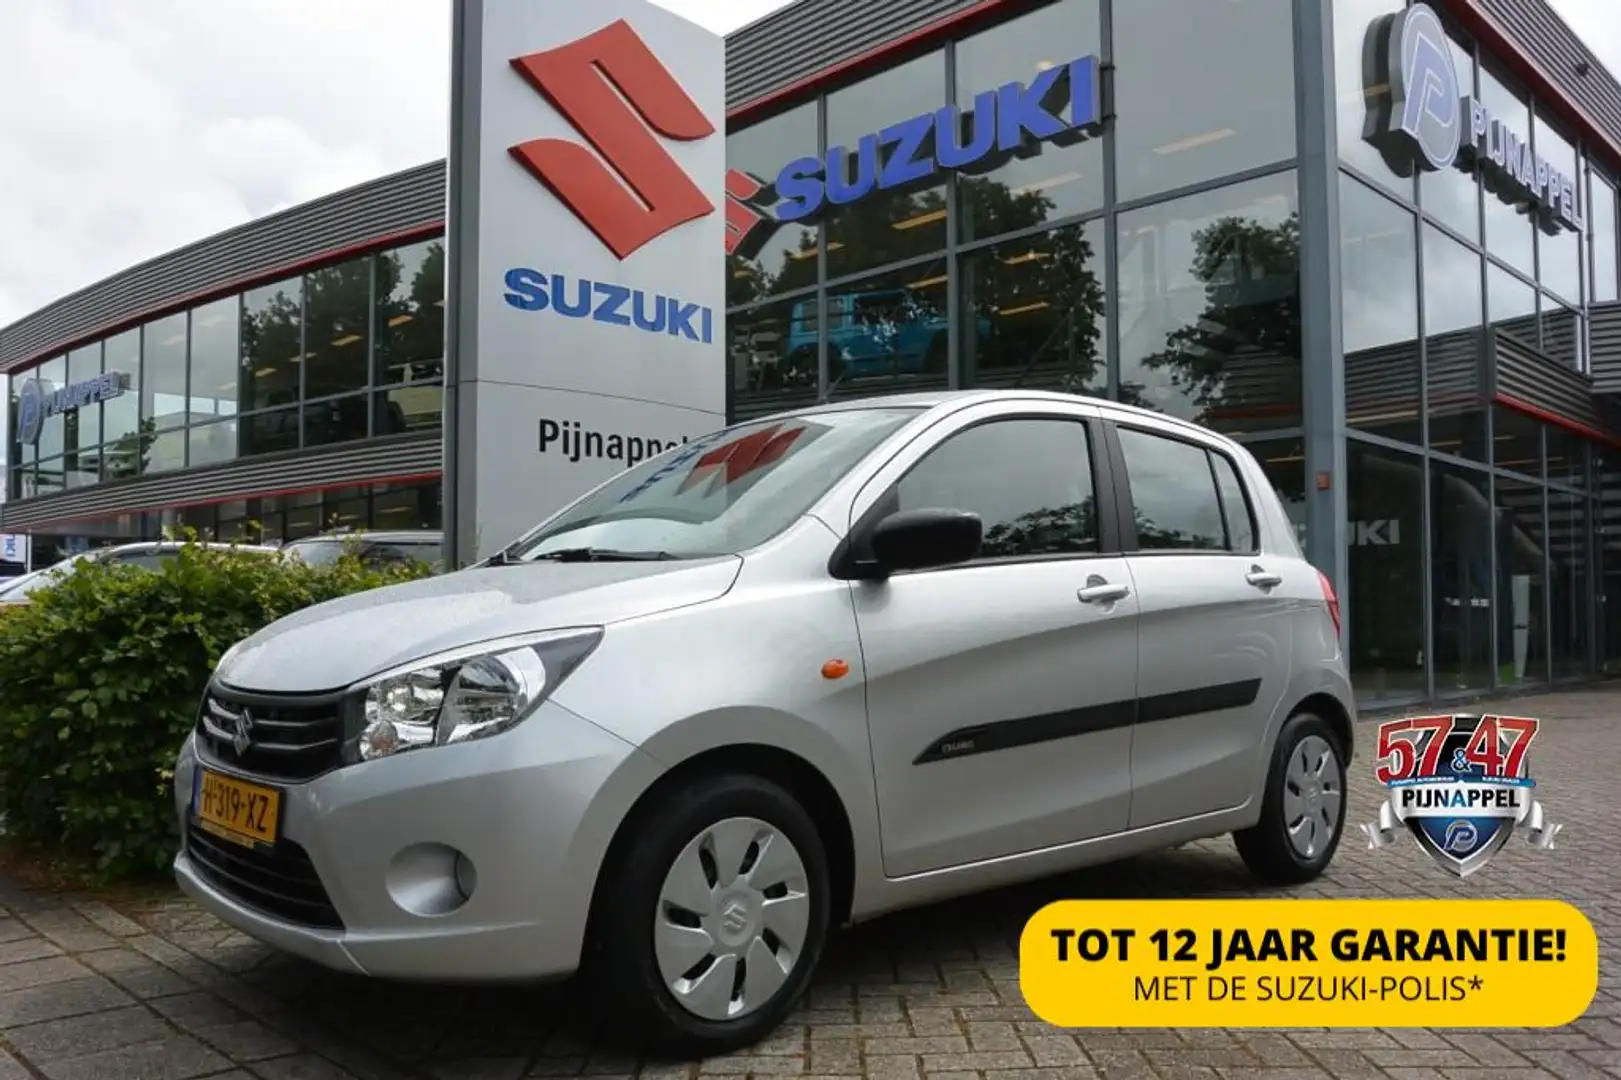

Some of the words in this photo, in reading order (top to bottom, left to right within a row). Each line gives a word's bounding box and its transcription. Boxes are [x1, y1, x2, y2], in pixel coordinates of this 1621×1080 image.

[774, 55, 1100, 224] SUZUKI
[1469, 97, 1585, 232] PIJNAPPEL
[503, 267, 712, 345] SUZUKI
[539, 418, 688, 468] Pijnapp
[203, 776, 269, 833] H-319-XZ
